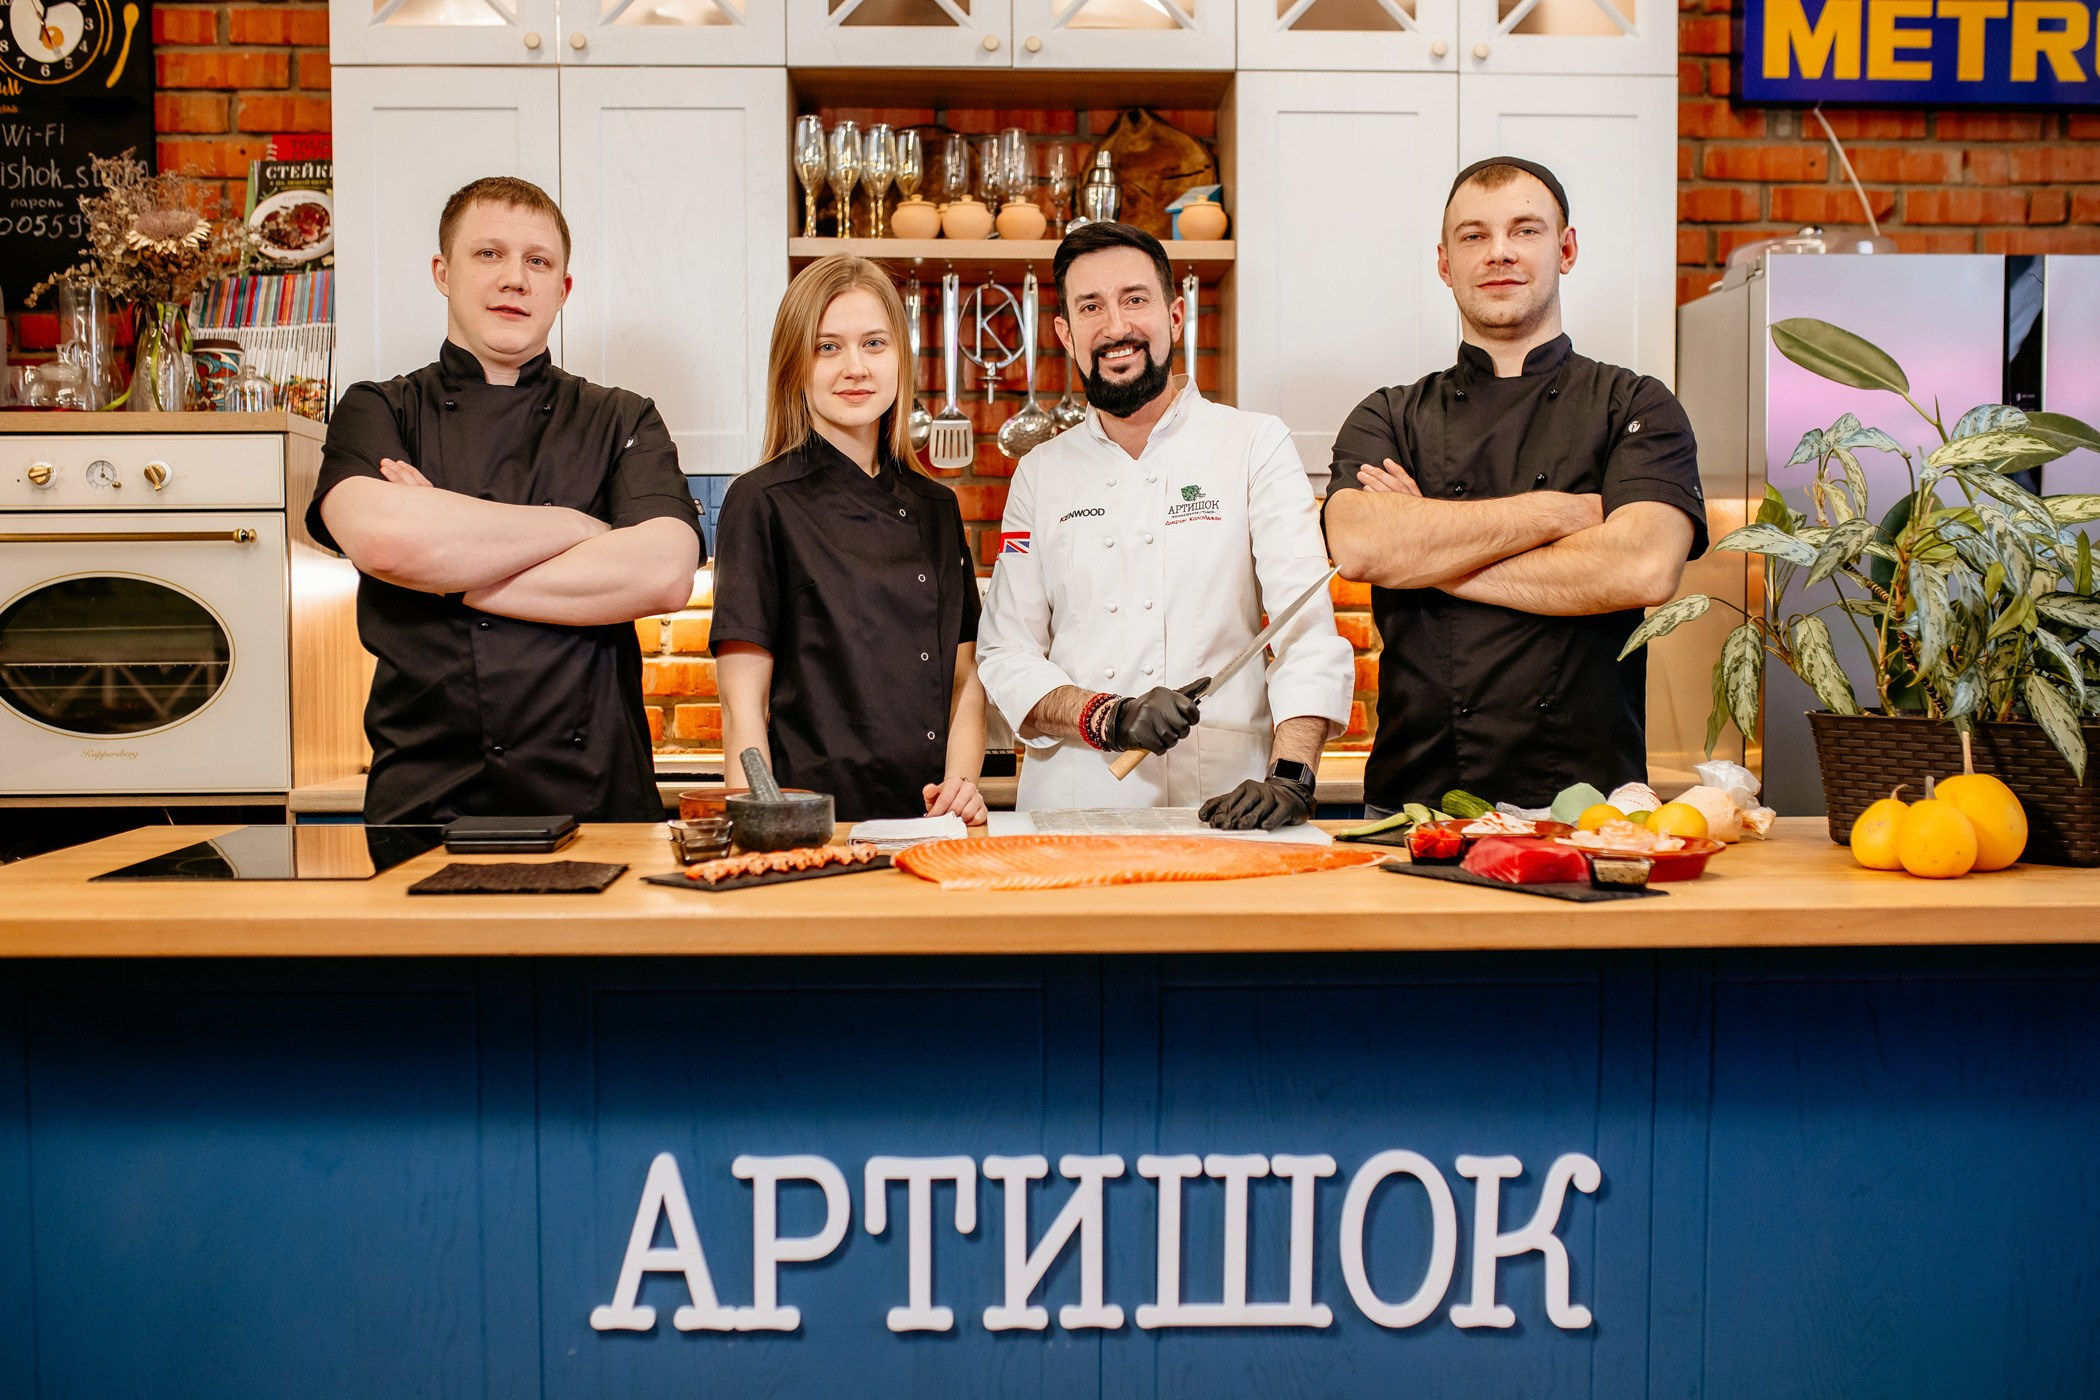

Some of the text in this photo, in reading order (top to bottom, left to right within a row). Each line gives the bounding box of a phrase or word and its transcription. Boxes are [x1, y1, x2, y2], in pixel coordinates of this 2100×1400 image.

[84, 18, 94, 31] 3
[79, 40, 88, 53] 4
[1763, 0, 2100, 82] METR
[16, 57, 26, 70] 7
[65, 57, 74, 70] 5
[40, 64, 51, 77] 6
[2, 123, 65, 147] Wi-Fi
[10, 198, 64, 210] пароль
[1168, 500, 1220, 515] АРТИШОК
[1059, 507, 1106, 523] KENWOOD
[589, 1149, 1600, 1331] АРТИШОК
